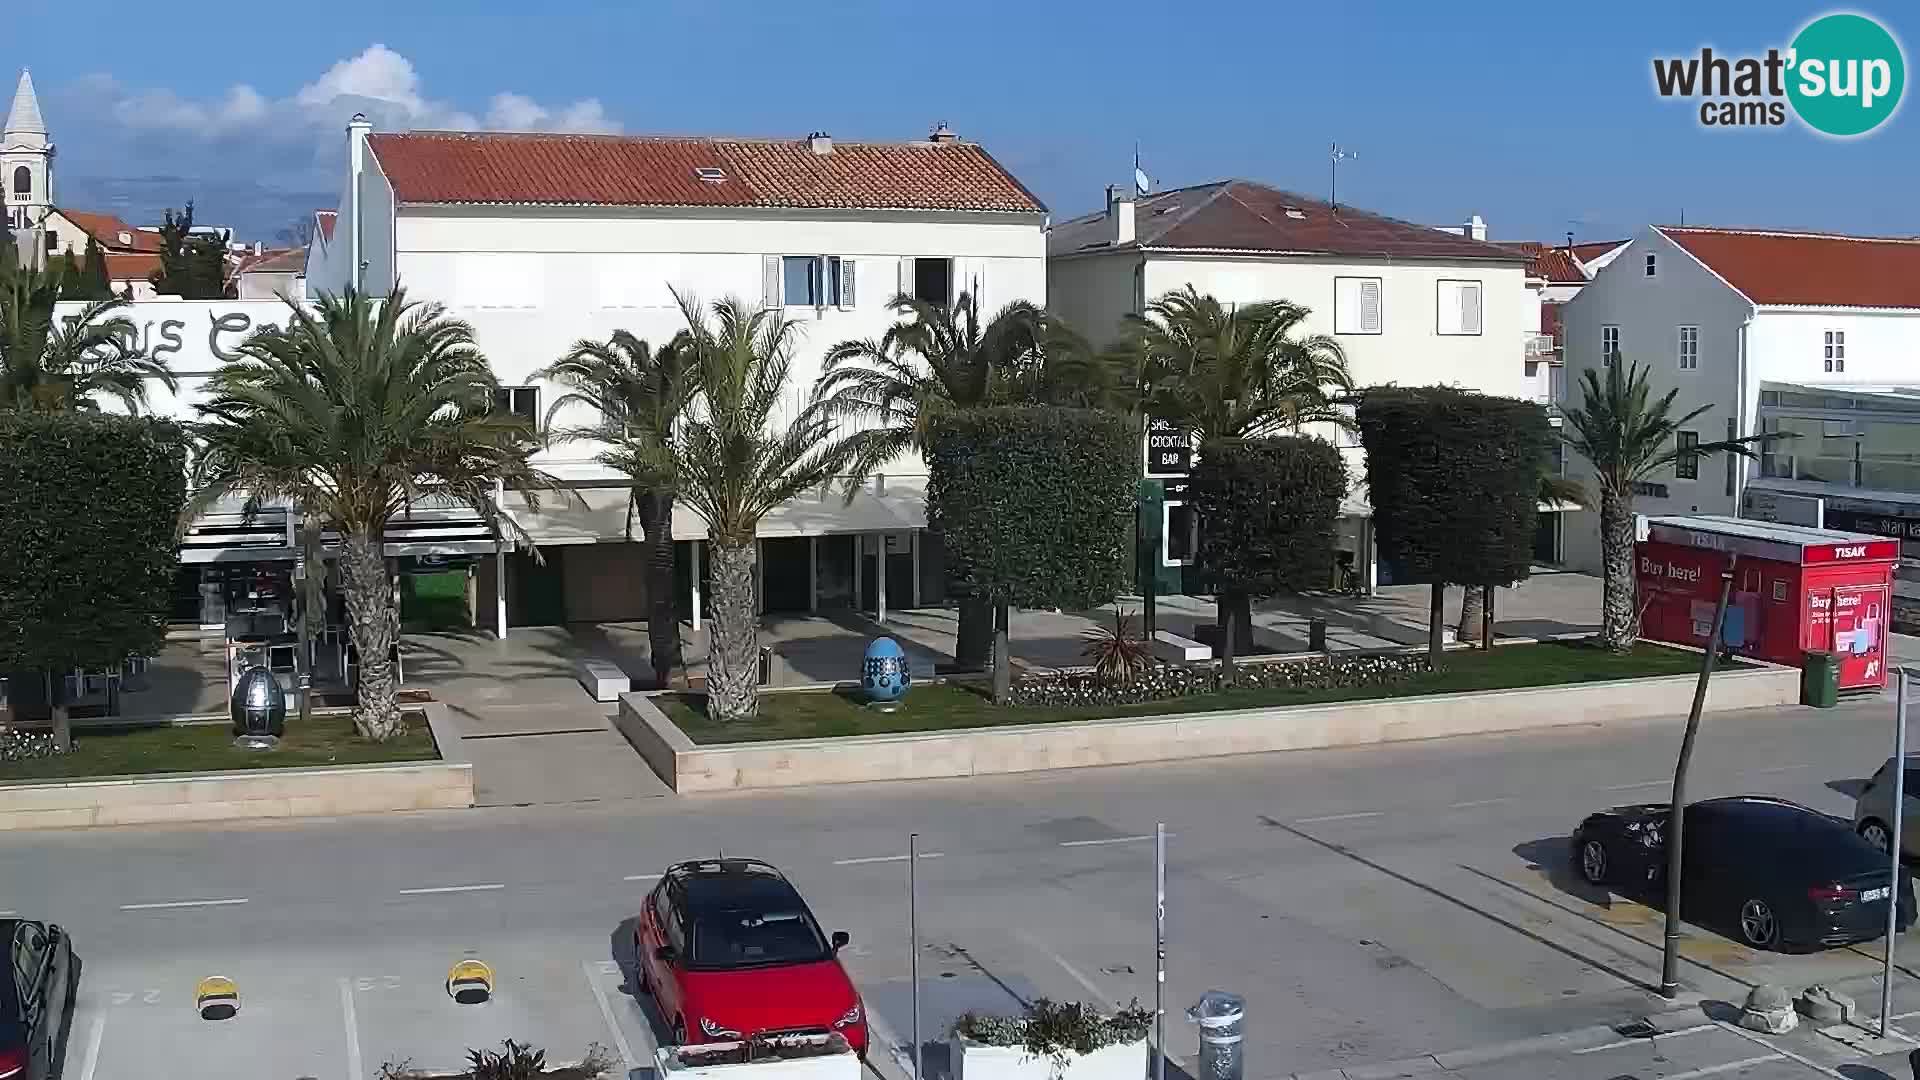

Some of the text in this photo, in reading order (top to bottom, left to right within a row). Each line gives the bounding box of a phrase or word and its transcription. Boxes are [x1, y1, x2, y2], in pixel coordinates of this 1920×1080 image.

[1151, 435, 1190, 448] COCKTAIL
[1162, 452, 1179, 465] BAR
[1835, 545, 1866, 558] TISAK
[1641, 556, 1701, 584] Buy here!
[1811, 593, 1862, 609] Buy here!
